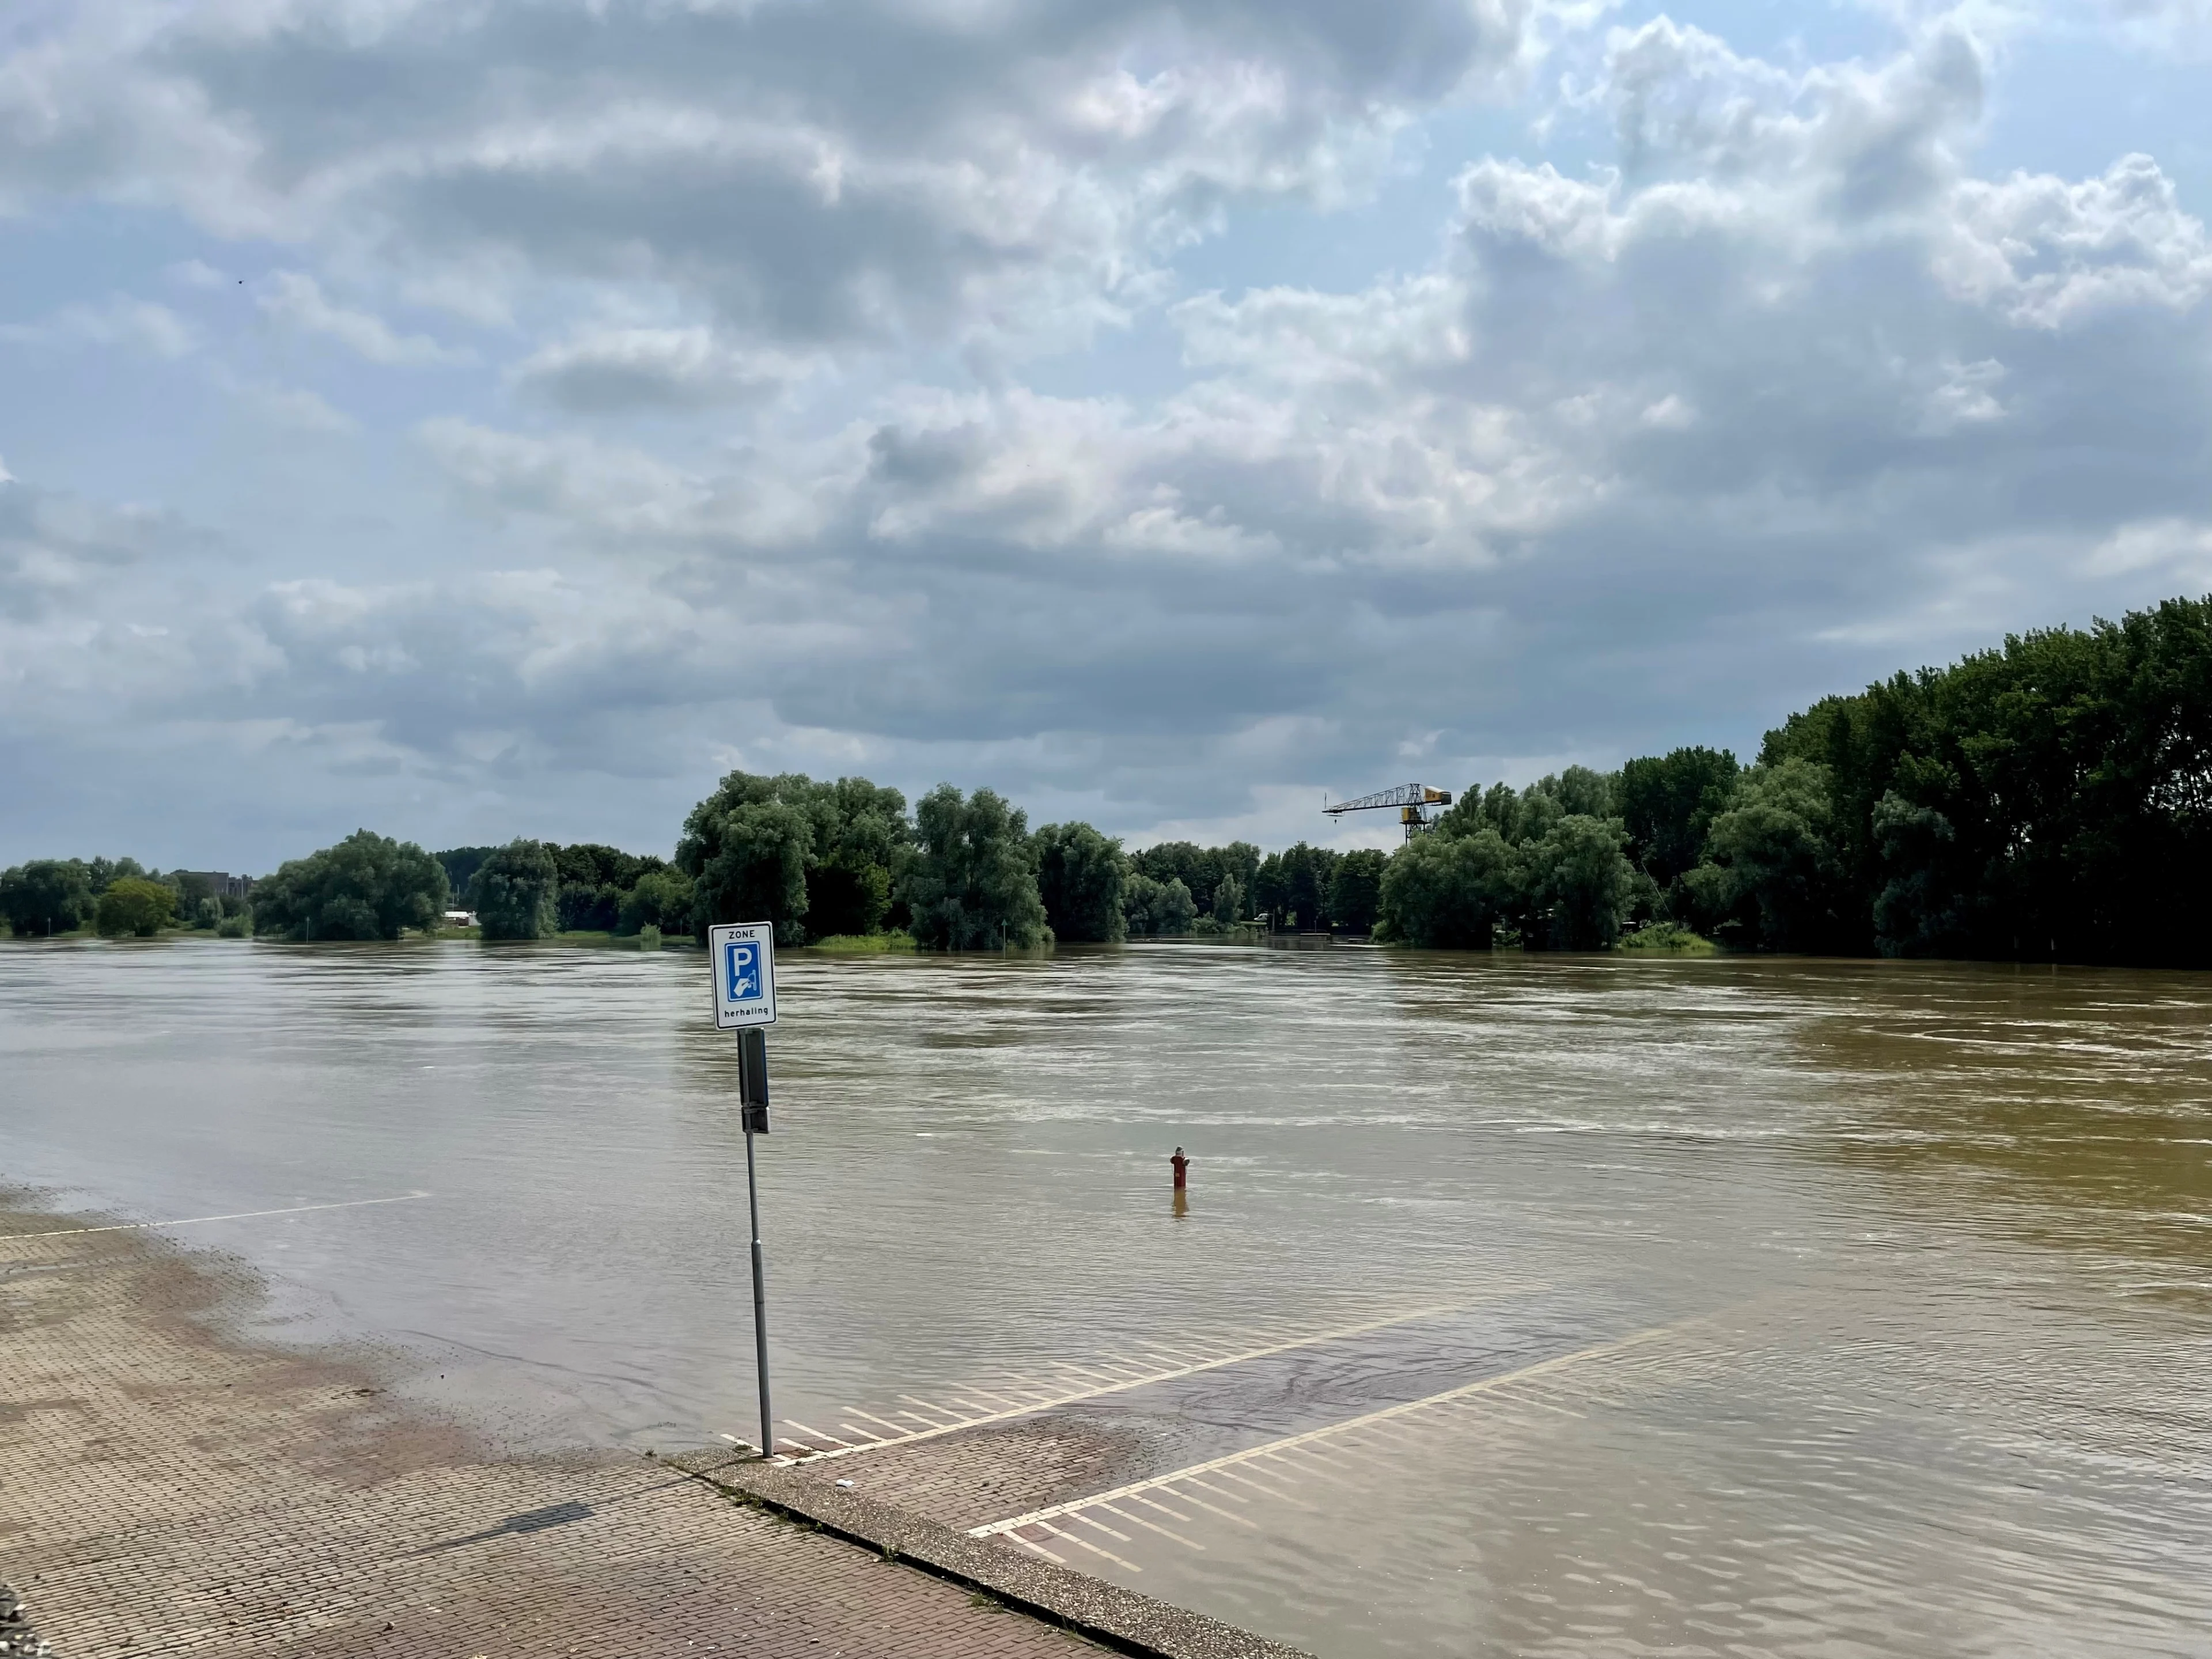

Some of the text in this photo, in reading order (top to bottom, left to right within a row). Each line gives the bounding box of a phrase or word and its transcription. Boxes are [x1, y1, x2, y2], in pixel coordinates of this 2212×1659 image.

[729, 930, 755, 939] ZONE
[733, 948, 752, 977] P
[724, 1007, 768, 1018] herhaling
